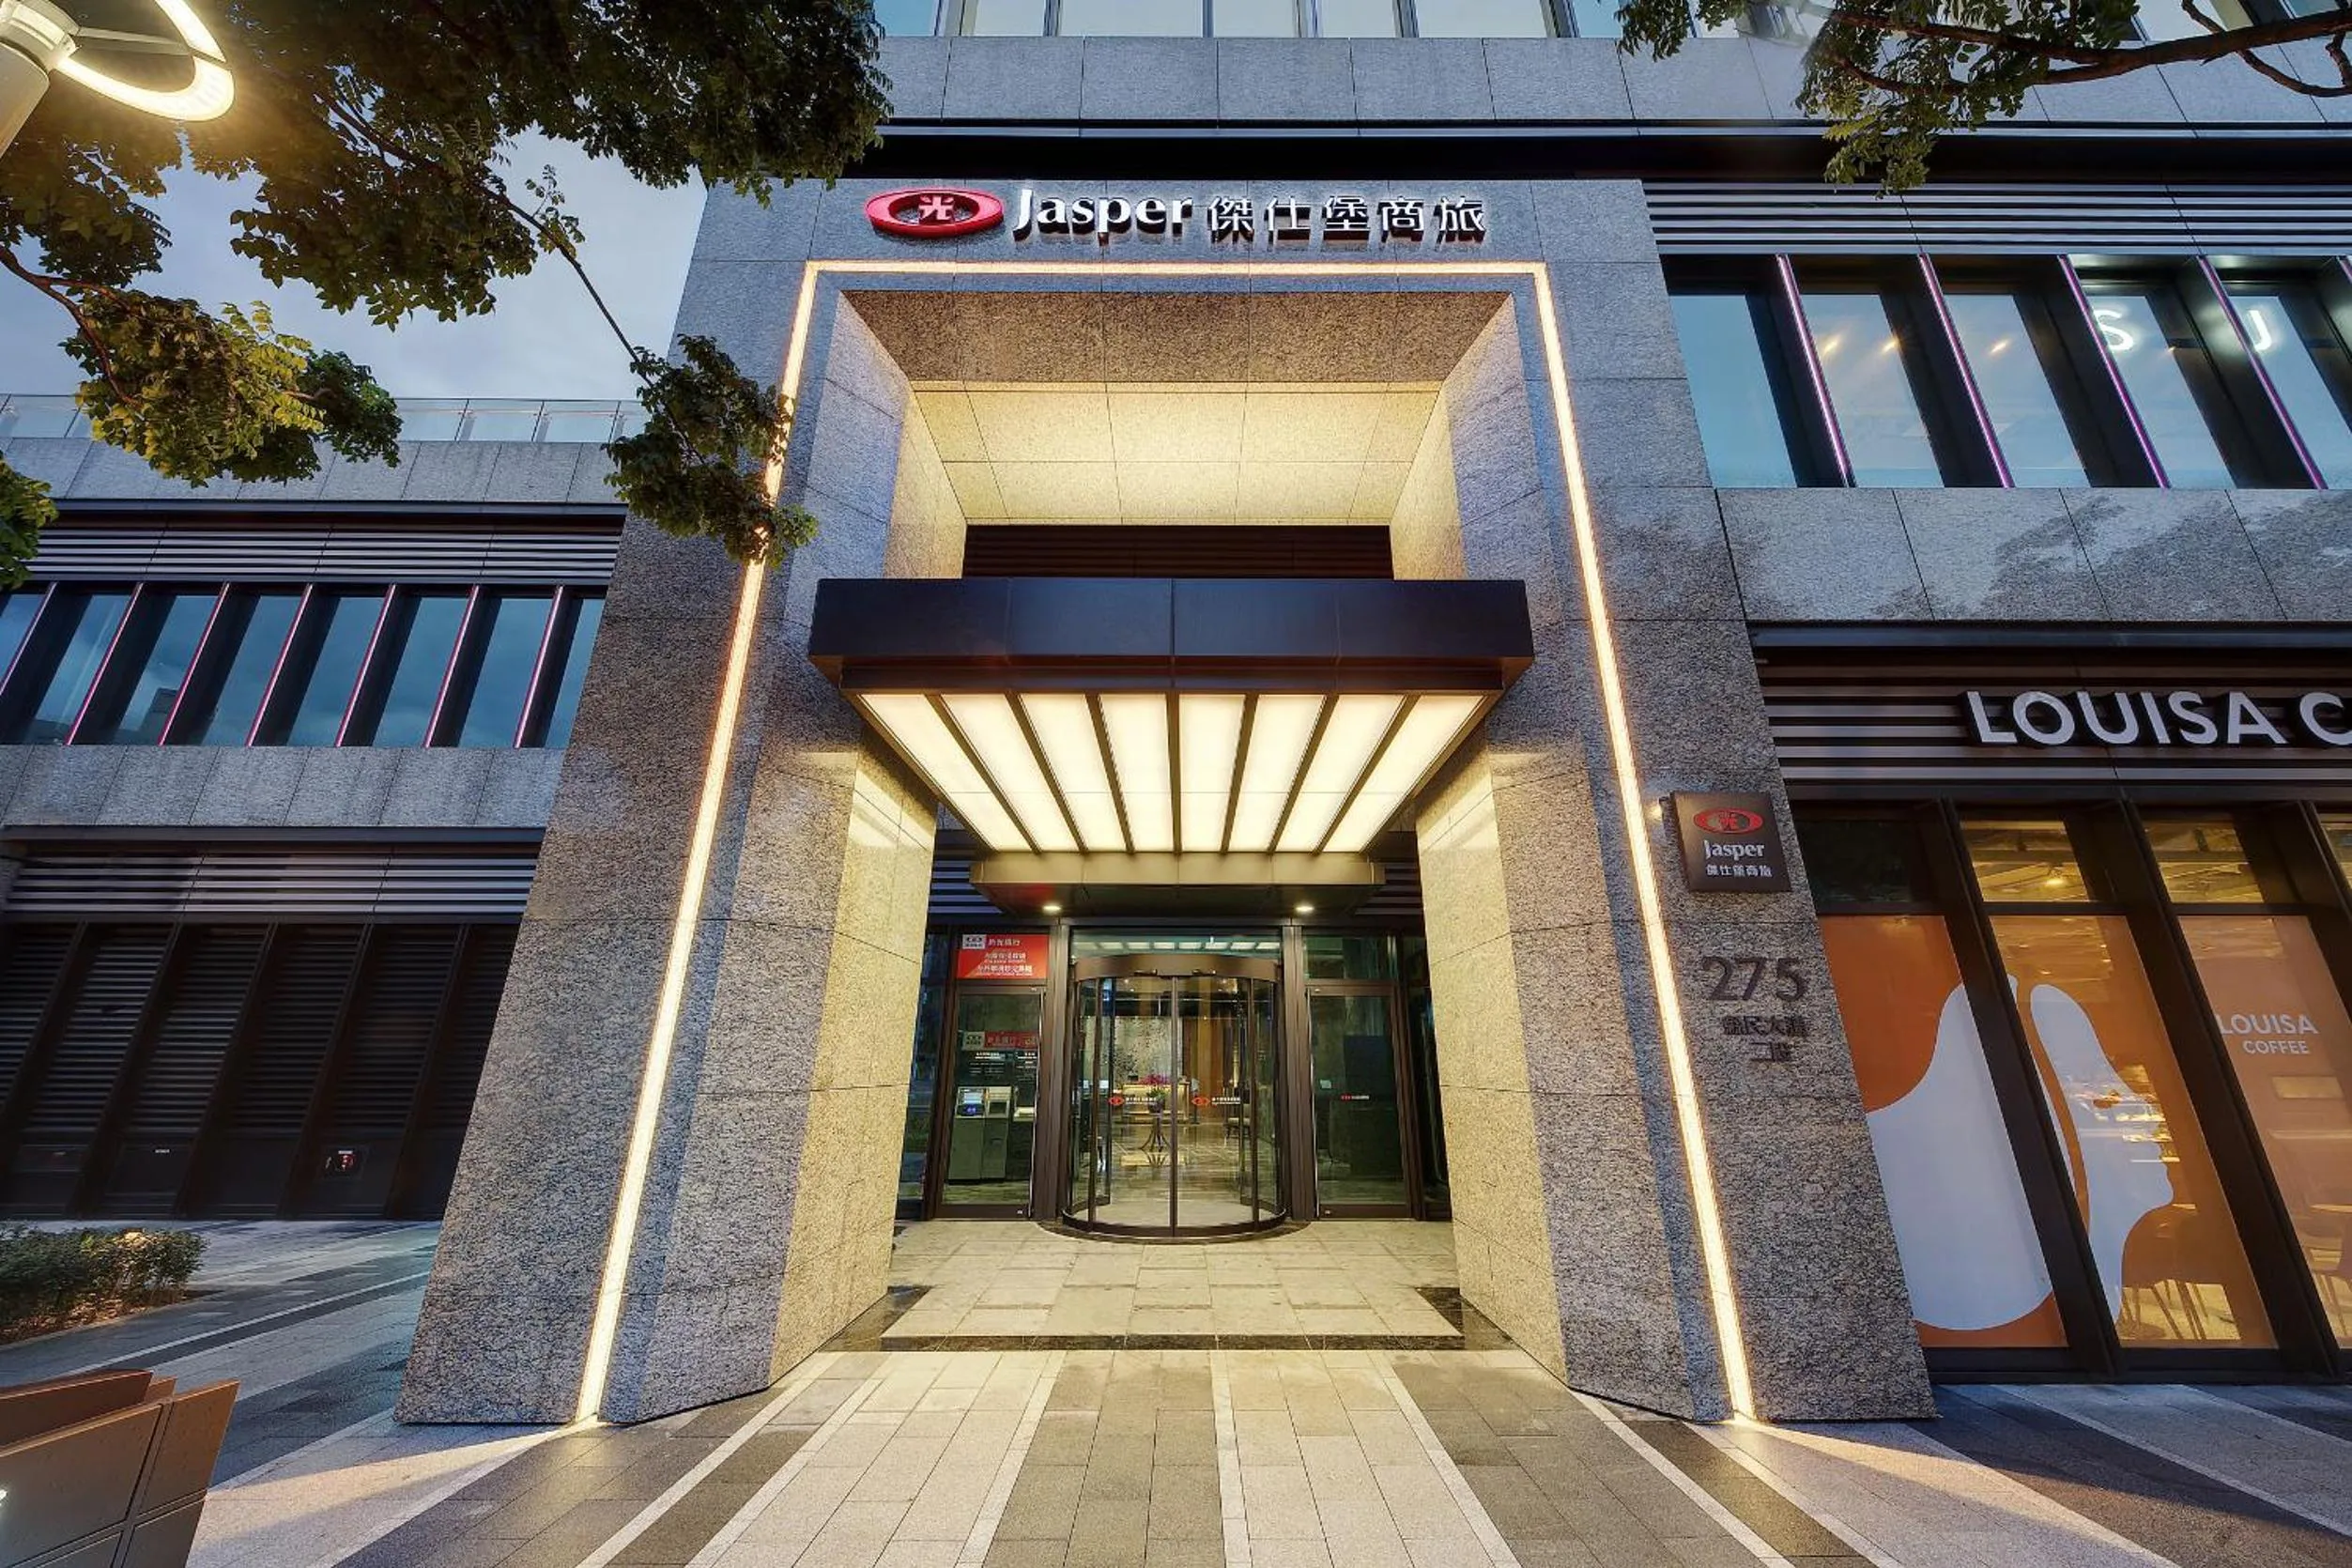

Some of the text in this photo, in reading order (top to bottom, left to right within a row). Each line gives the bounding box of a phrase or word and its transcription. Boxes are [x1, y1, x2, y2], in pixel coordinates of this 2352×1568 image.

[1013, 189, 1484, 233] Jasper 傑仕堡商旅
[1967, 690, 2289, 745] LOUISA
[1704, 839, 1765, 861] Jasper
[1701, 956, 1809, 1002] 275
[2215, 1013, 2319, 1035] LOUISA
[2242, 1039, 2311, 1055] COFFEE
